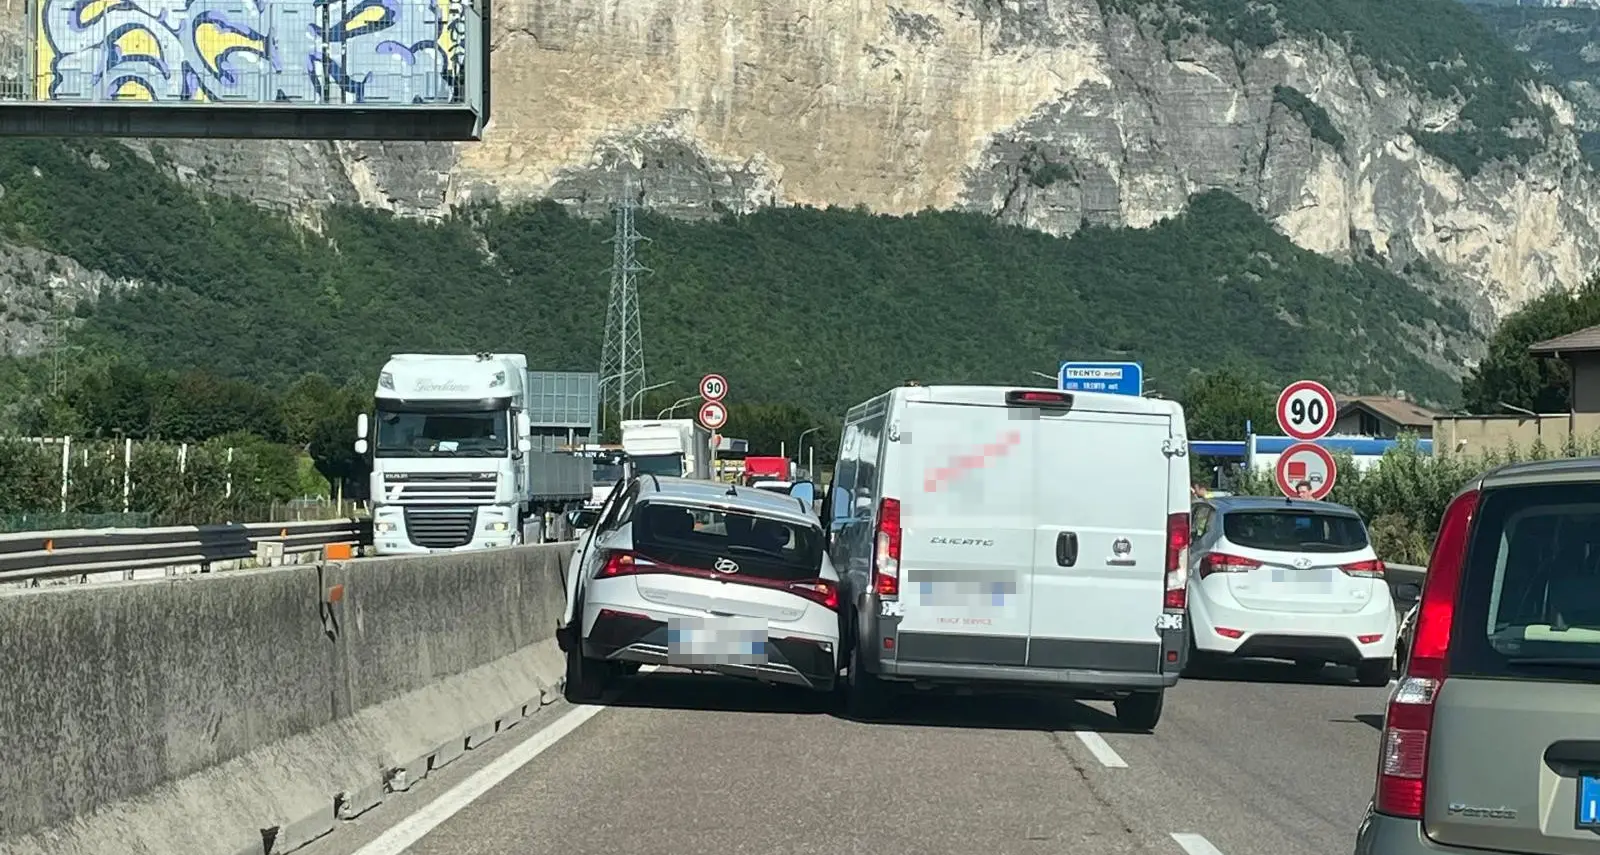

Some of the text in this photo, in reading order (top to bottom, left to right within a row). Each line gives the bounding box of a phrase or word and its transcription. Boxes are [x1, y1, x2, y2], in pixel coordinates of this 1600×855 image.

[1068, 369, 1101, 377] TRENTO
[707, 382, 721, 394] 90
[1291, 398, 1324, 425] 90
[930, 536, 994, 547] DUCATO
[1448, 803, 1517, 819] Panda
